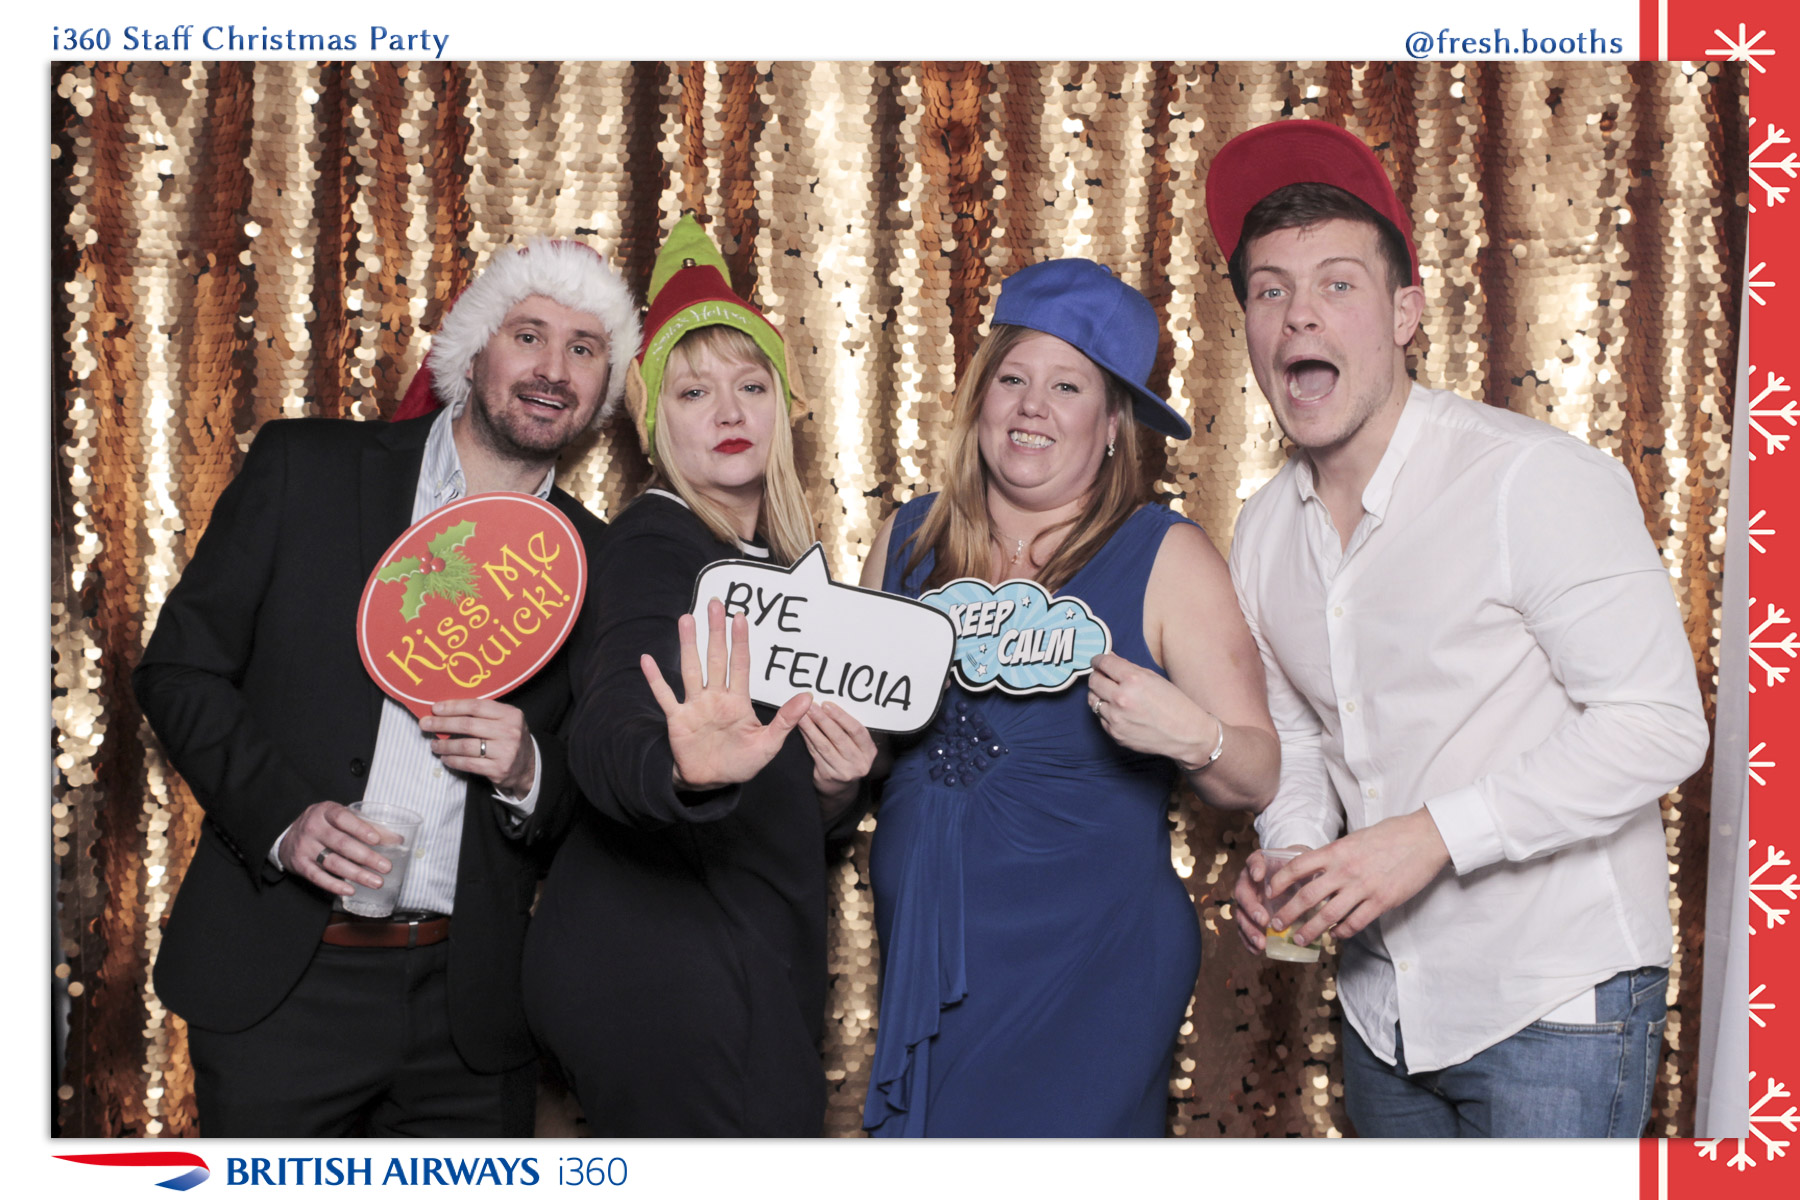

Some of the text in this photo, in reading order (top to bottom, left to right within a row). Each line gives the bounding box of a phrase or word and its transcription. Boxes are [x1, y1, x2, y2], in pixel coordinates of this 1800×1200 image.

[386, 531, 561, 686] Kiss Me
[446, 571, 570, 688] Quick!
[724, 581, 808, 633] BYE
[948, 599, 1016, 640] KEEP
[997, 626, 1077, 667] CALM
[764, 644, 911, 711] FELICIA
